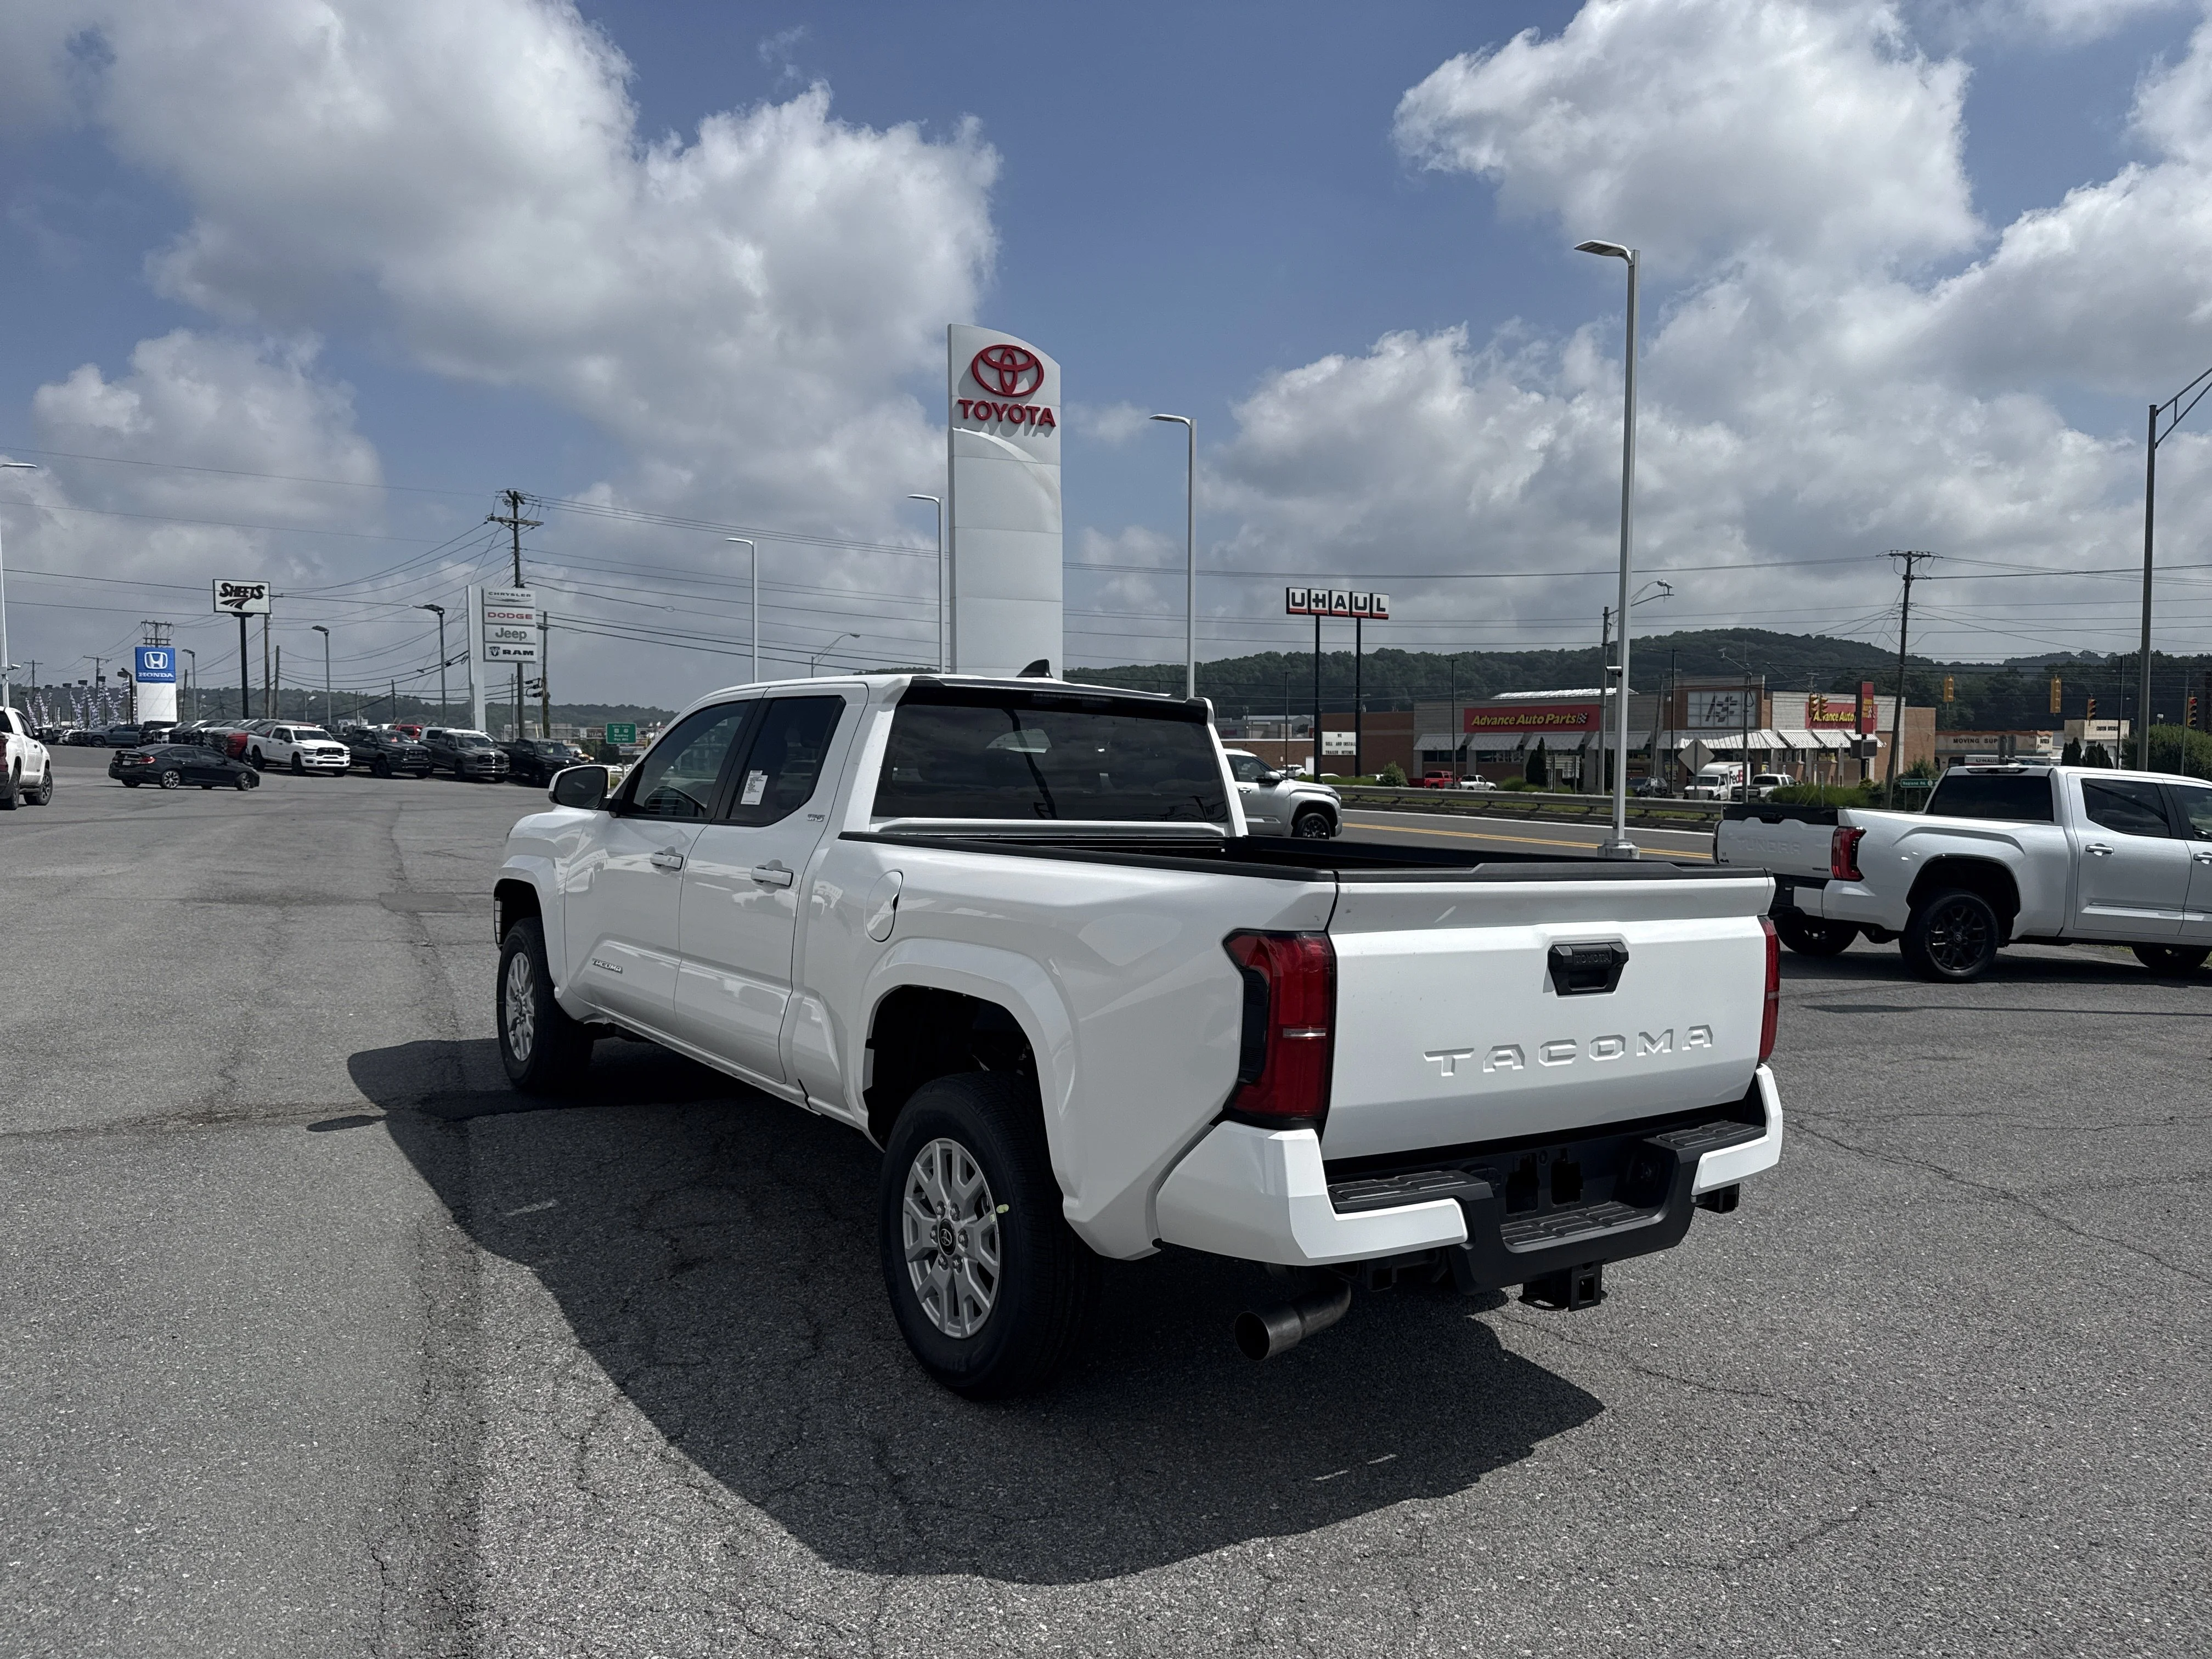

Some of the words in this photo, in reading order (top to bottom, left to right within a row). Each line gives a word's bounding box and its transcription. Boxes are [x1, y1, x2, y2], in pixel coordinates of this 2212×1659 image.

[958, 399, 1056, 427] TOYOTA
[219, 583, 265, 600] SHEETS
[495, 628, 527, 641] Jeep
[1471, 714, 1516, 726] Advance
[1516, 714, 1544, 725] Auto
[1545, 713, 1577, 724] Parts
[1813, 711, 1839, 722] Avance
[1839, 712, 1854, 722] Auto
[1729, 769, 1743, 785] FedE
[1736, 836, 1803, 855] TUNDRA
[1575, 952, 1611, 963] TOYOTA
[592, 959, 622, 972] TACOMA
[1424, 1024, 1713, 1076] TACOMA
